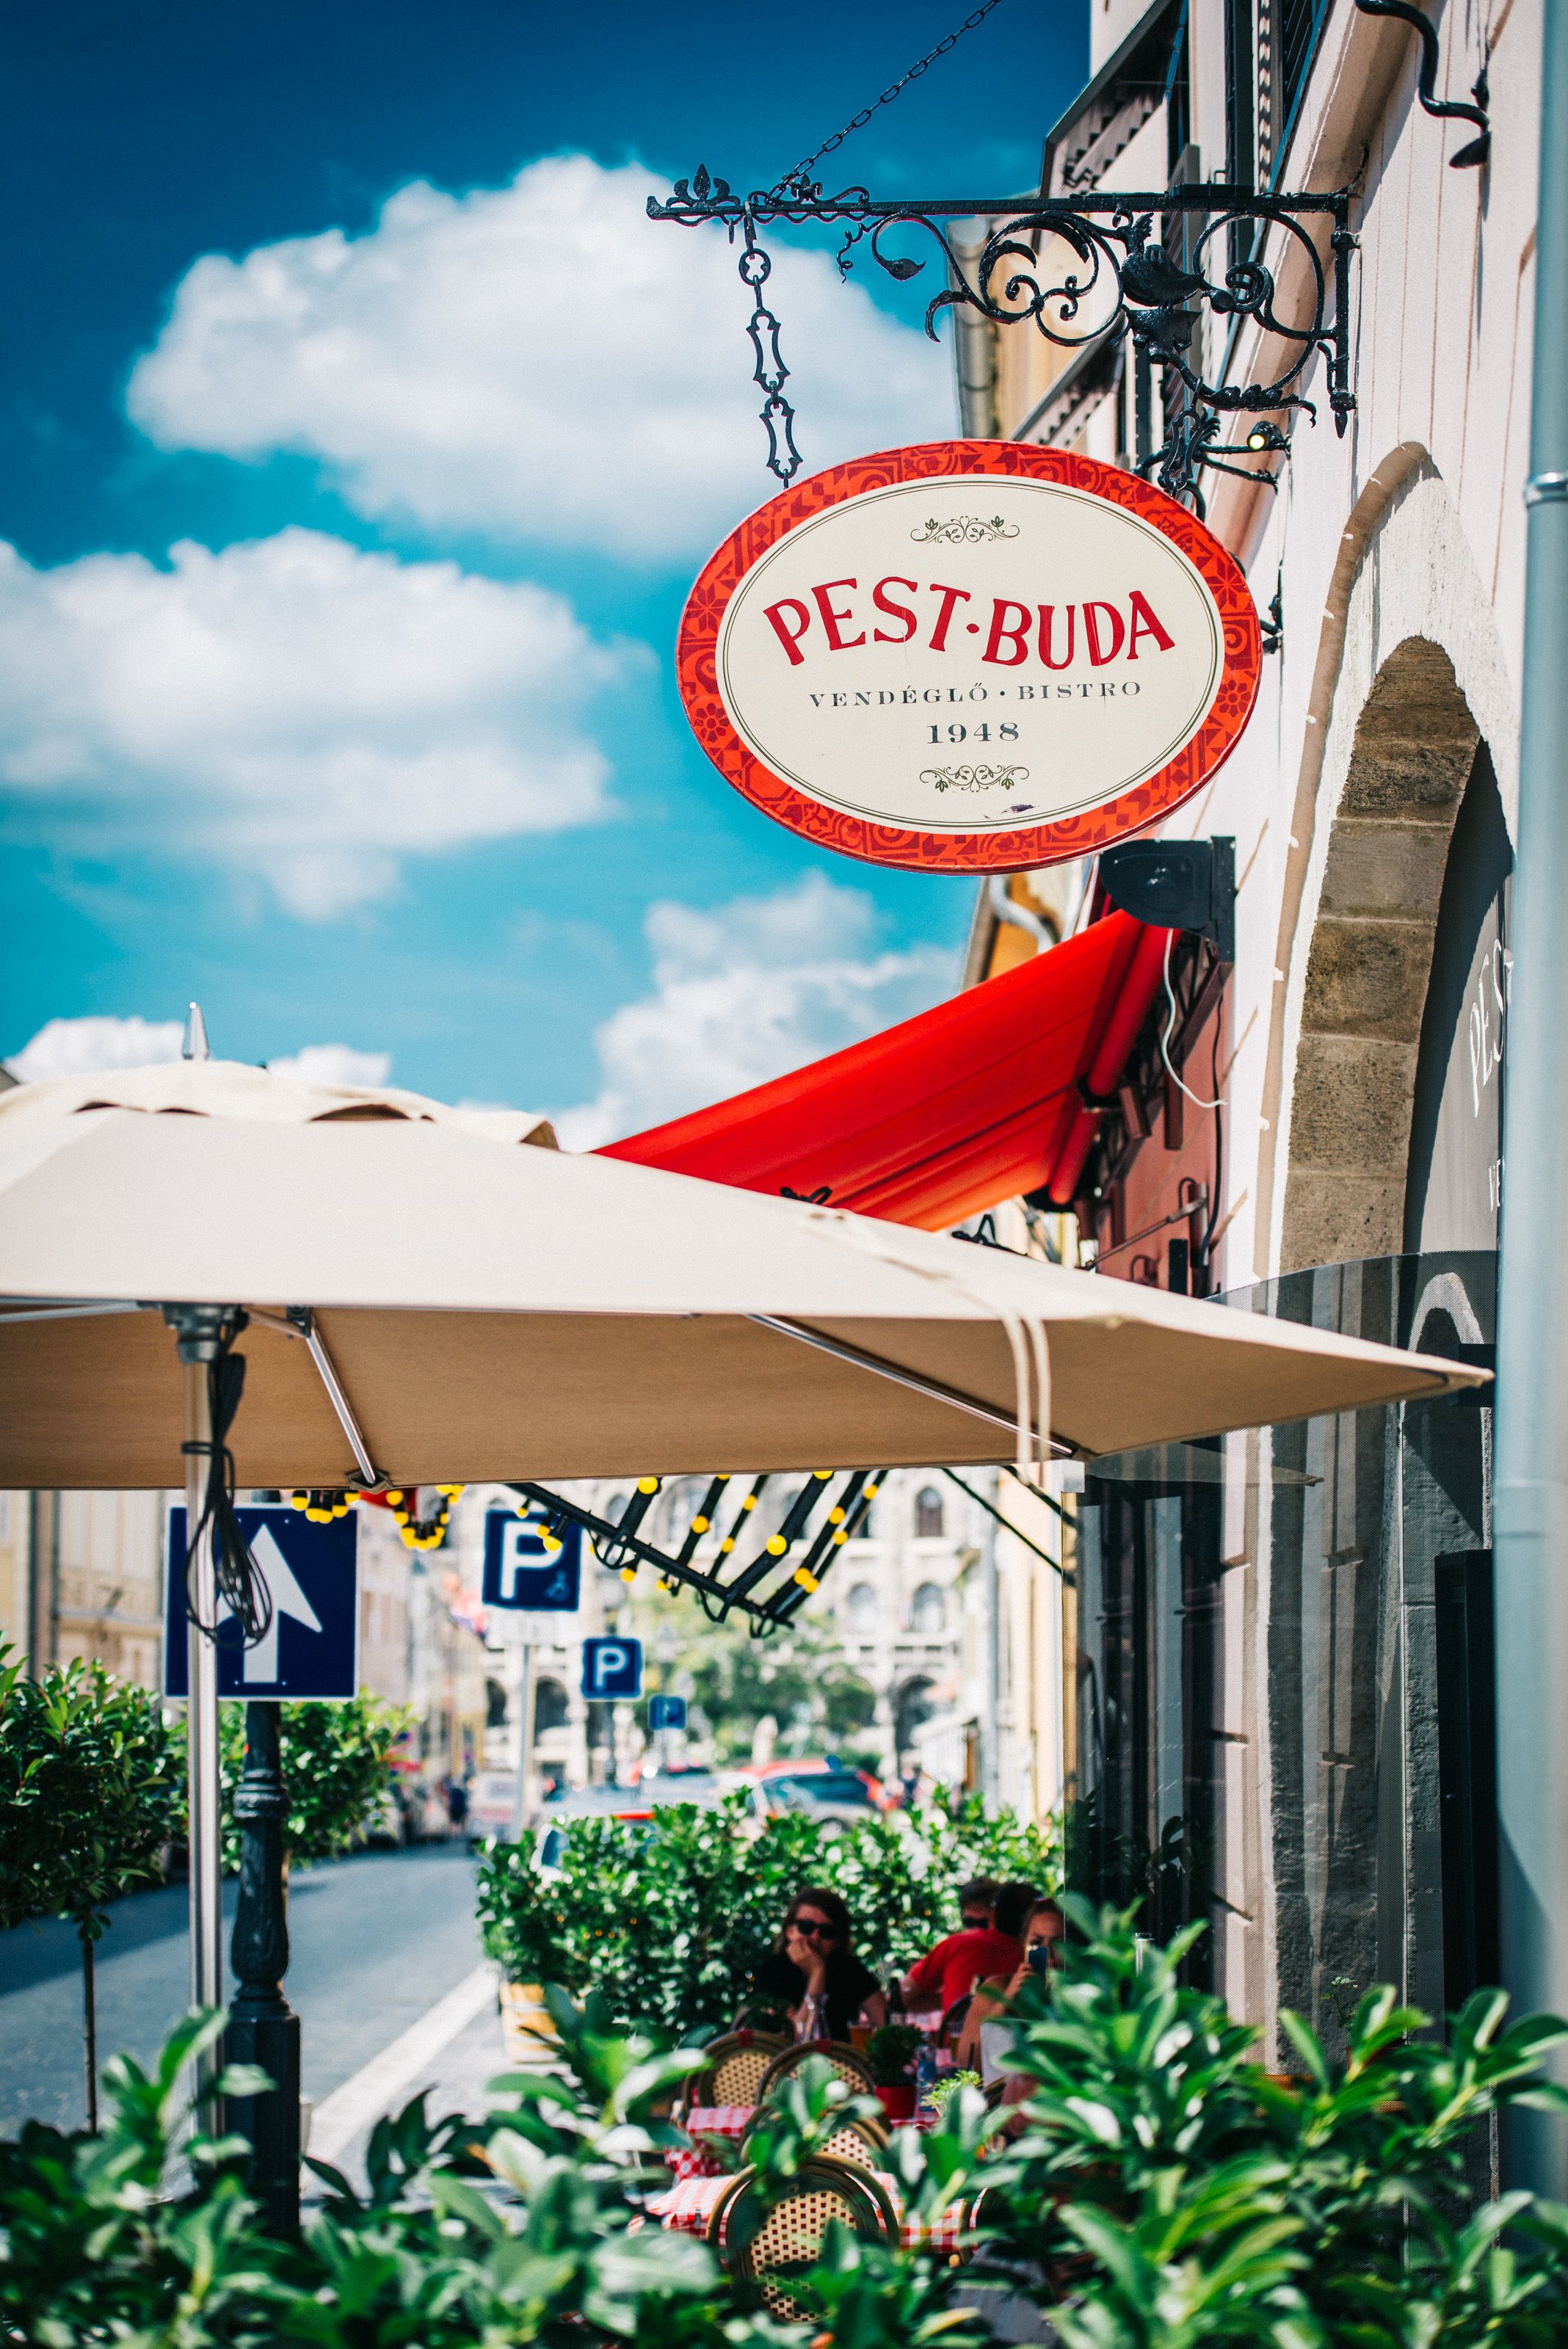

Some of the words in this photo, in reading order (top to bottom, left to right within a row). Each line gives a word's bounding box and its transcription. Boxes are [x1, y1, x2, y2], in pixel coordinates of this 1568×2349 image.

[809, 682, 988, 708] VENDÉGLŐ
[1017, 680, 1141, 700] BISTRO
[926, 722, 1020, 744] 1948
[500, 1520, 563, 1600] P
[595, 1646, 628, 1688] P
